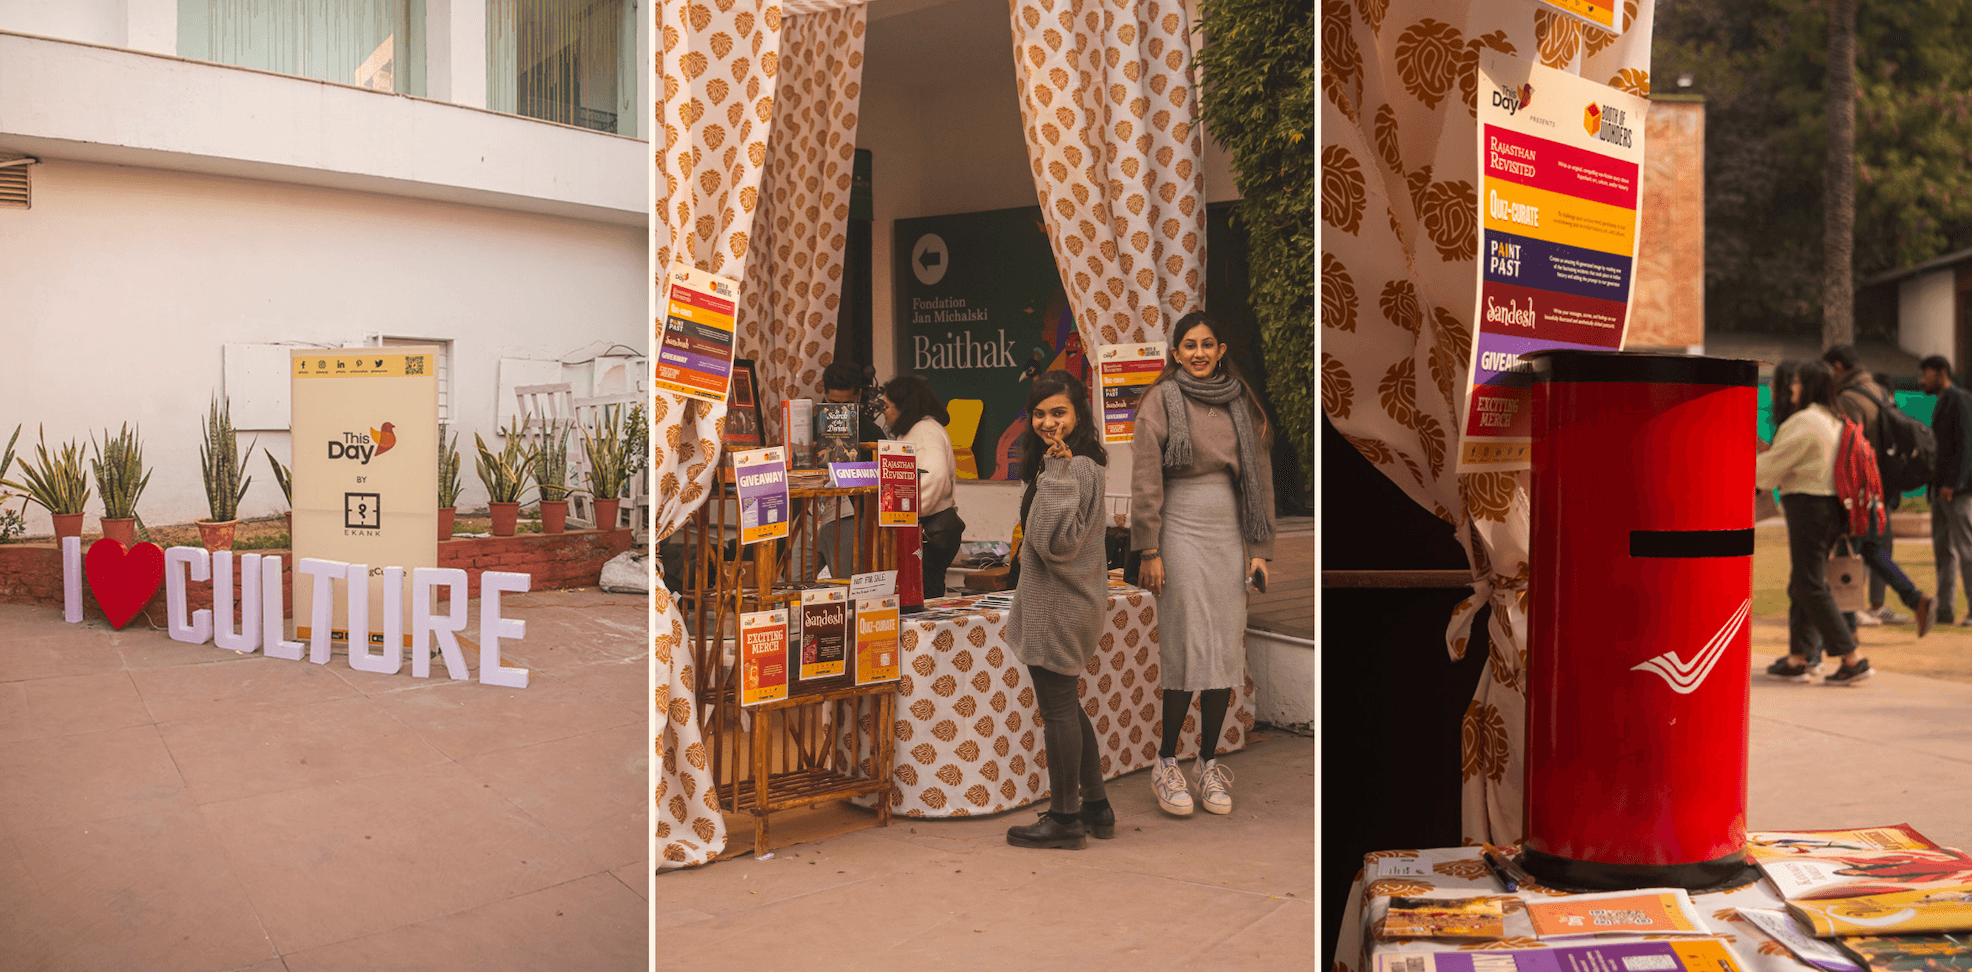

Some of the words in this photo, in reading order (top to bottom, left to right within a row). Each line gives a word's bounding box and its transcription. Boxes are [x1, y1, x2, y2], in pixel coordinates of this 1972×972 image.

[1502, 85, 1516, 99] This
[1493, 90, 1518, 115] Day
[1530, 115, 1555, 128] PRESENTS
[1600, 121, 1632, 148] WONDERS
[1491, 240, 1521, 260] PAINT
[1490, 256, 1521, 277] PAST
[912, 296, 966, 310] Fondation
[912, 311, 931, 324] Jan
[934, 308, 988, 323] Michalski
[1486, 296, 1536, 329] Sandesh
[912, 328, 1018, 369] Baithak
[1479, 412, 1512, 427] MERCH
[343, 432, 370, 445] This
[328, 441, 374, 465] Day
[356, 476, 367, 484] BY
[739, 470, 784, 488] GIVEAWAY
[344, 529, 381, 537] EKANK
[873, 573, 886, 583] SALE
[62, 536, 83, 623] I
[164, 545, 531, 689] CULTURE
[804, 605, 844, 628] Sandesh
[746, 629, 784, 645] EXCITING
[751, 640, 780, 655] MERCH
